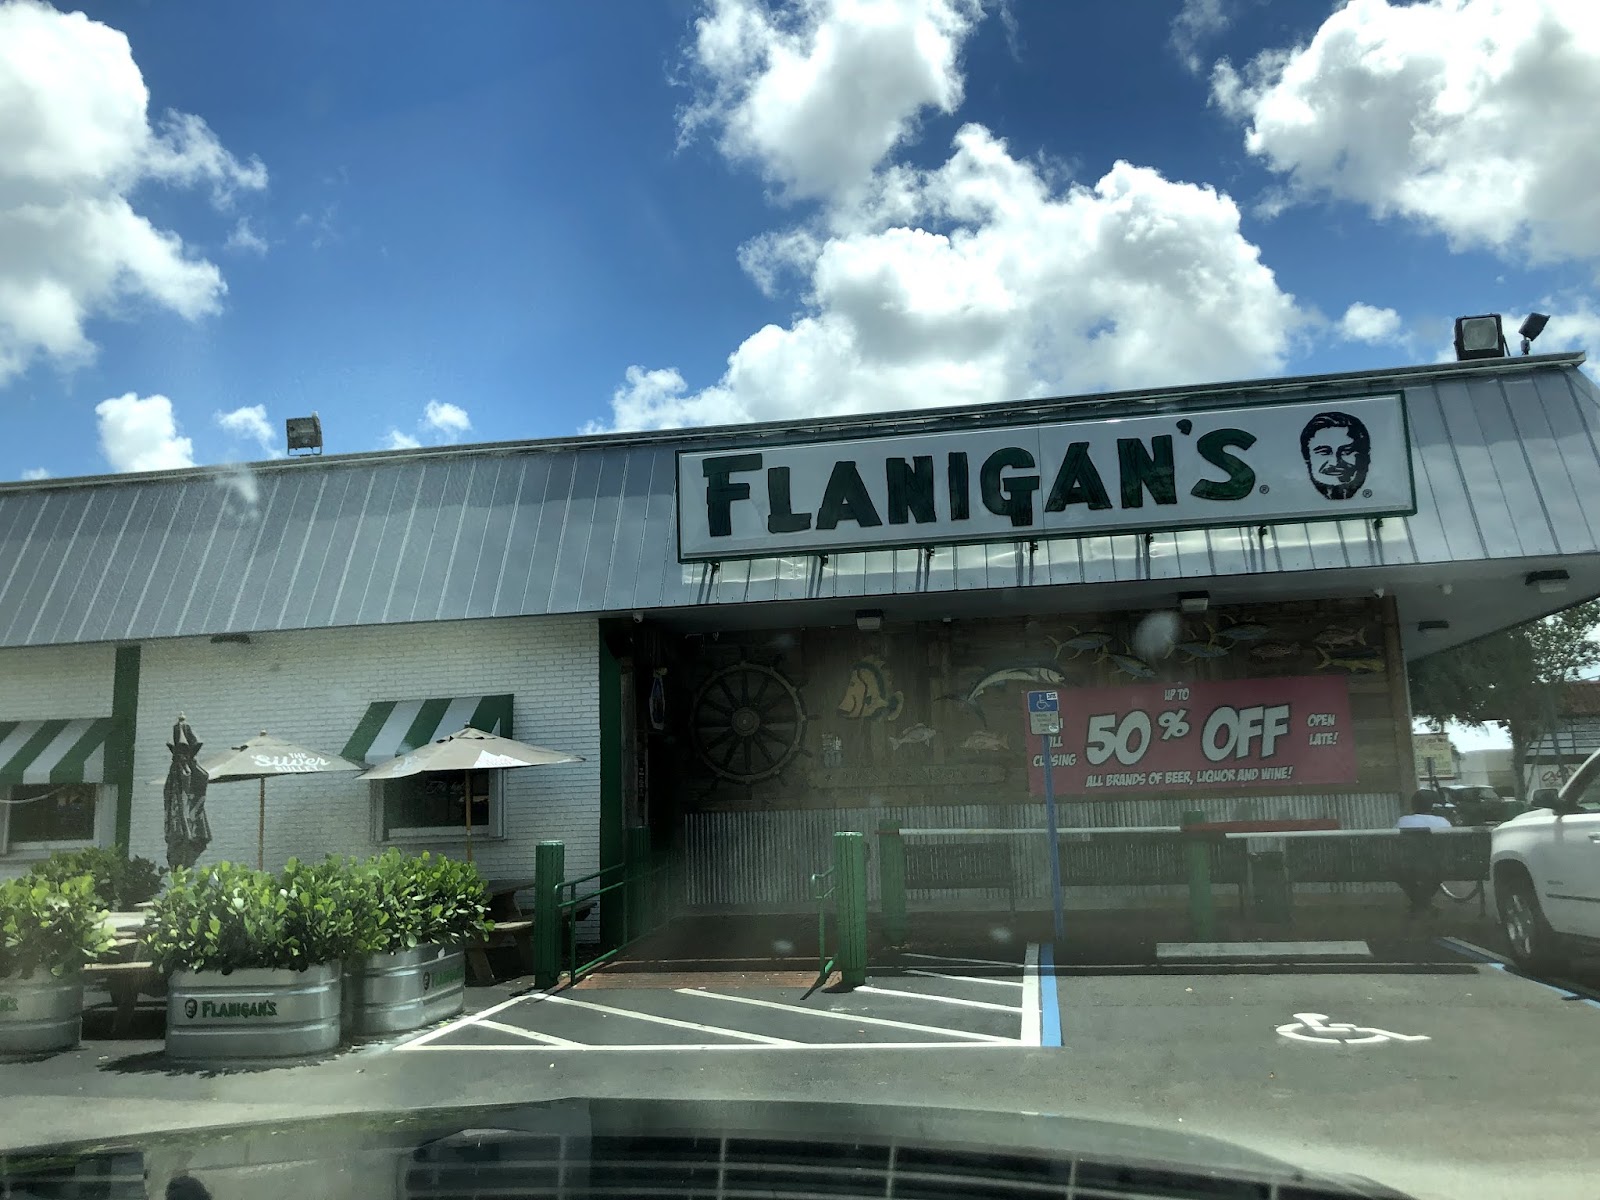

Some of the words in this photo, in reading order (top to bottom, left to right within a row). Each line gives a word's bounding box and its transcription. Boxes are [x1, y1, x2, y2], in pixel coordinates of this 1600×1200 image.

[702, 419, 1257, 537] FLANIGAN'S
[1164, 688, 1176, 701] UP
[1177, 687, 1190, 701] TO
[1307, 713, 1336, 727] OPEN
[1202, 704, 1290, 762] OFF
[1308, 732, 1339, 745] LATE!
[1032, 753, 1077, 768] CLSING
[1085, 775, 1104, 788] ALL
[1105, 773, 1147, 787] BRANDS
[1148, 772, 1163, 785] OF
[1164, 771, 1193, 786] BEER,
[1196, 769, 1236, 783] LIQUOR
[1237, 768, 1259, 781] AND
[1260, 766, 1294, 780] WINE!
[201, 999, 278, 1019] FLANIGAN'S
